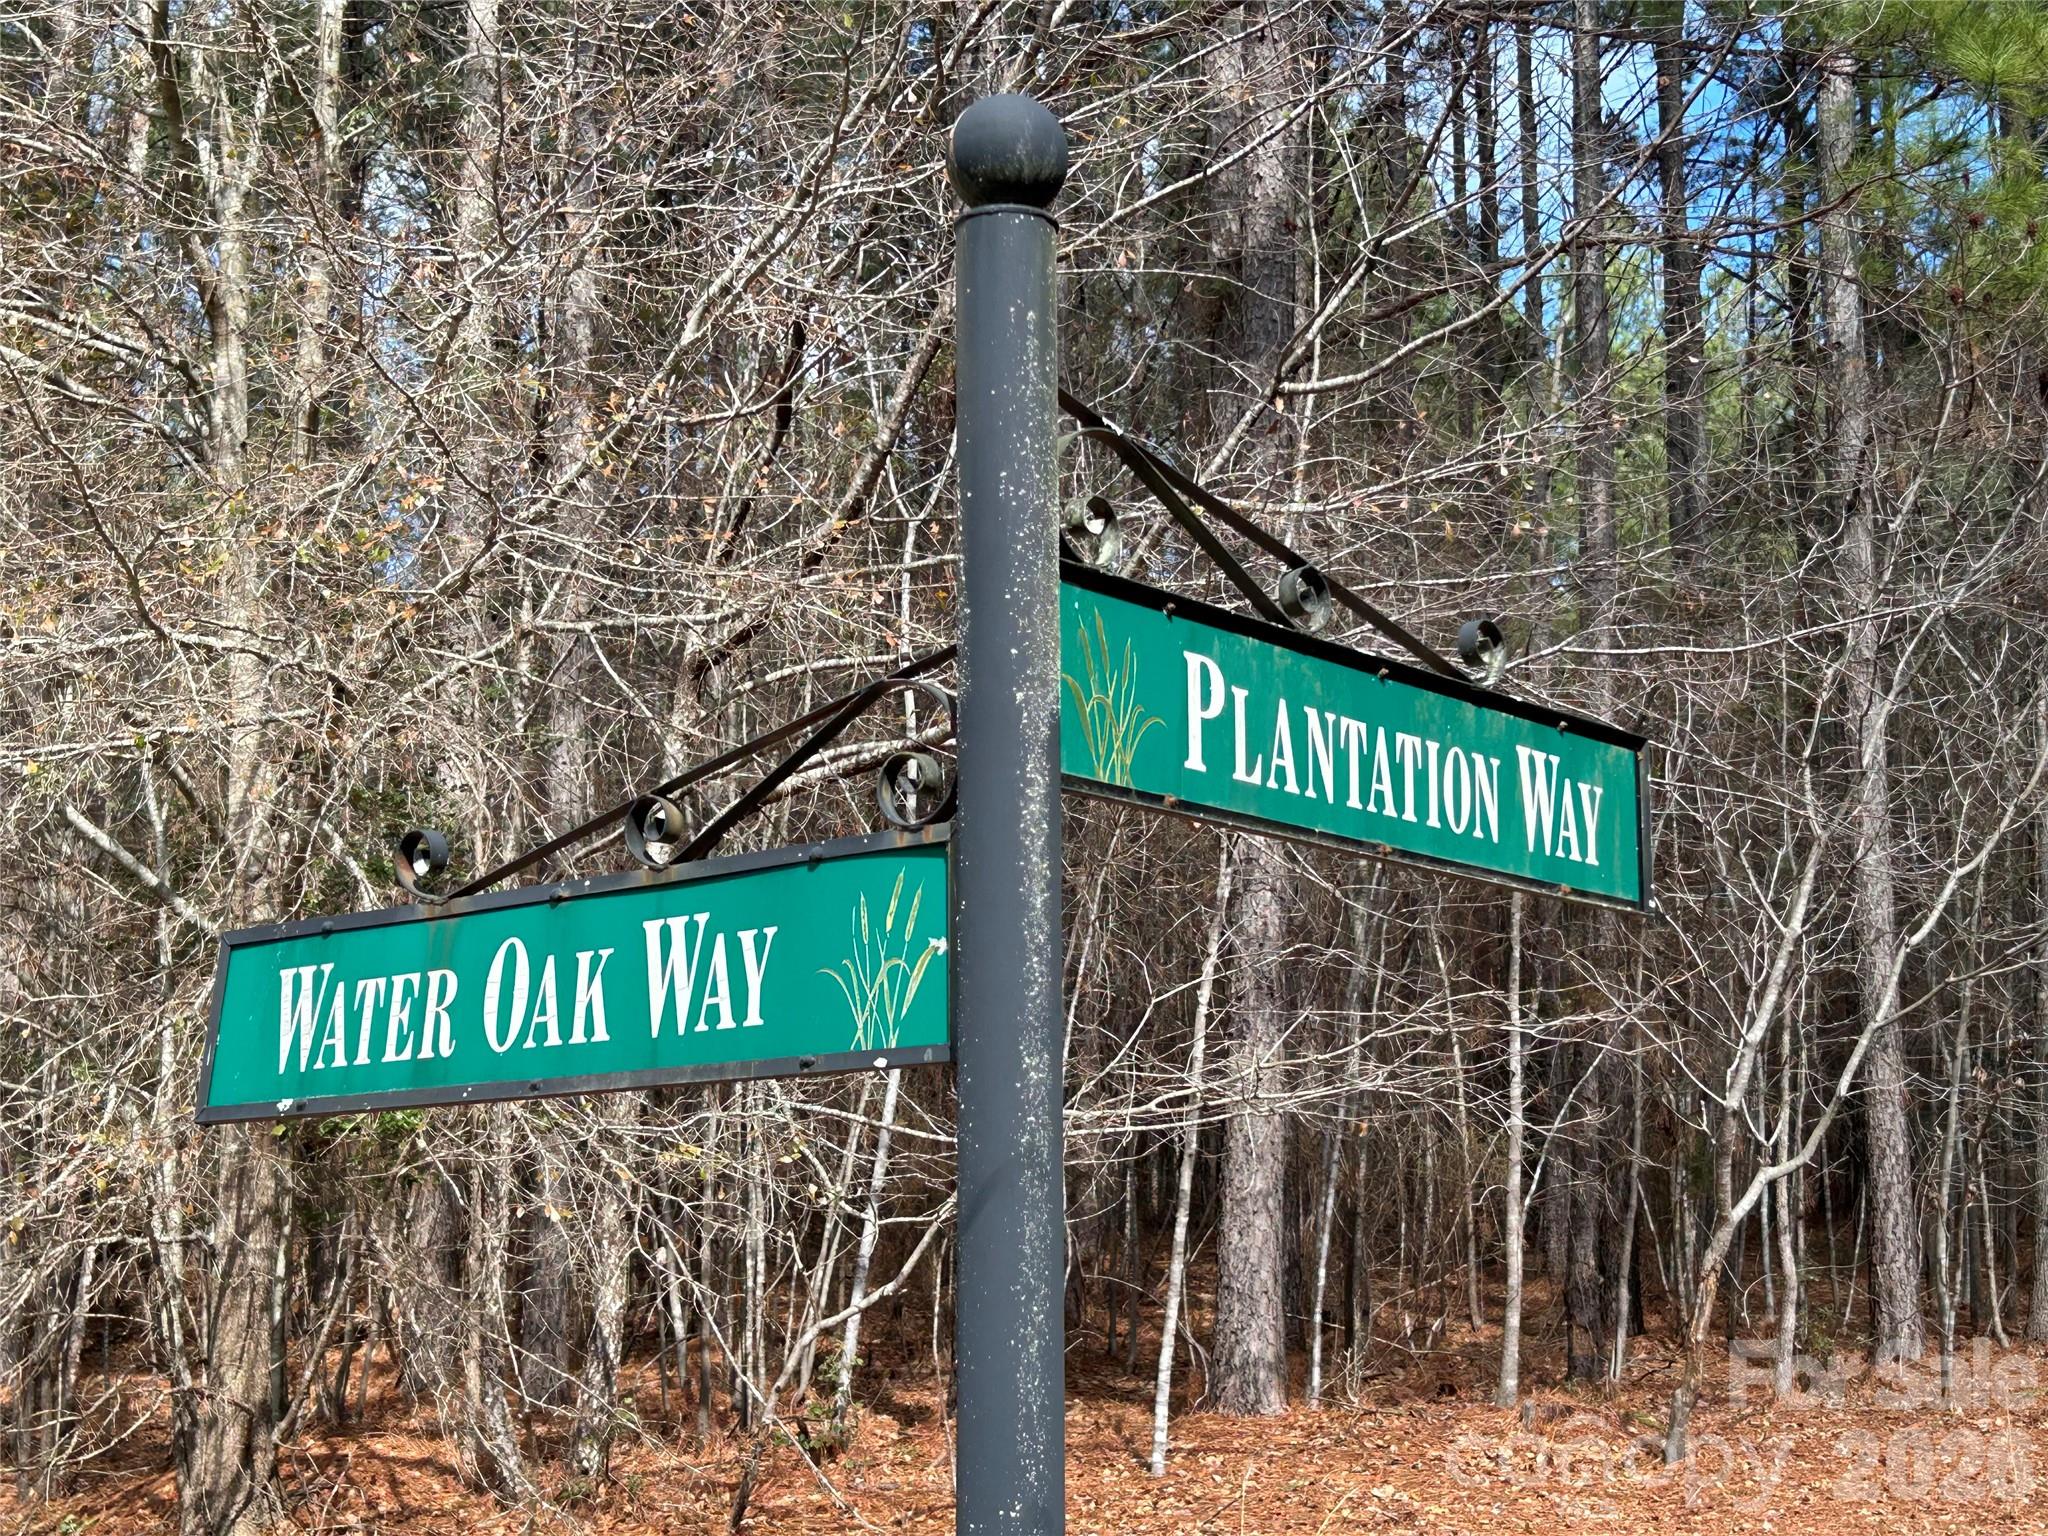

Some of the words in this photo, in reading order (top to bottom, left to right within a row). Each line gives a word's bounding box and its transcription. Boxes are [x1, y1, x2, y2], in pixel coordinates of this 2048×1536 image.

[1183, 650, 1501, 844] PLANTATION
[1515, 744, 1603, 866] WAY
[278, 962, 458, 1074] WATER
[483, 936, 614, 1053] OAK
[642, 911, 778, 1038] WAY
